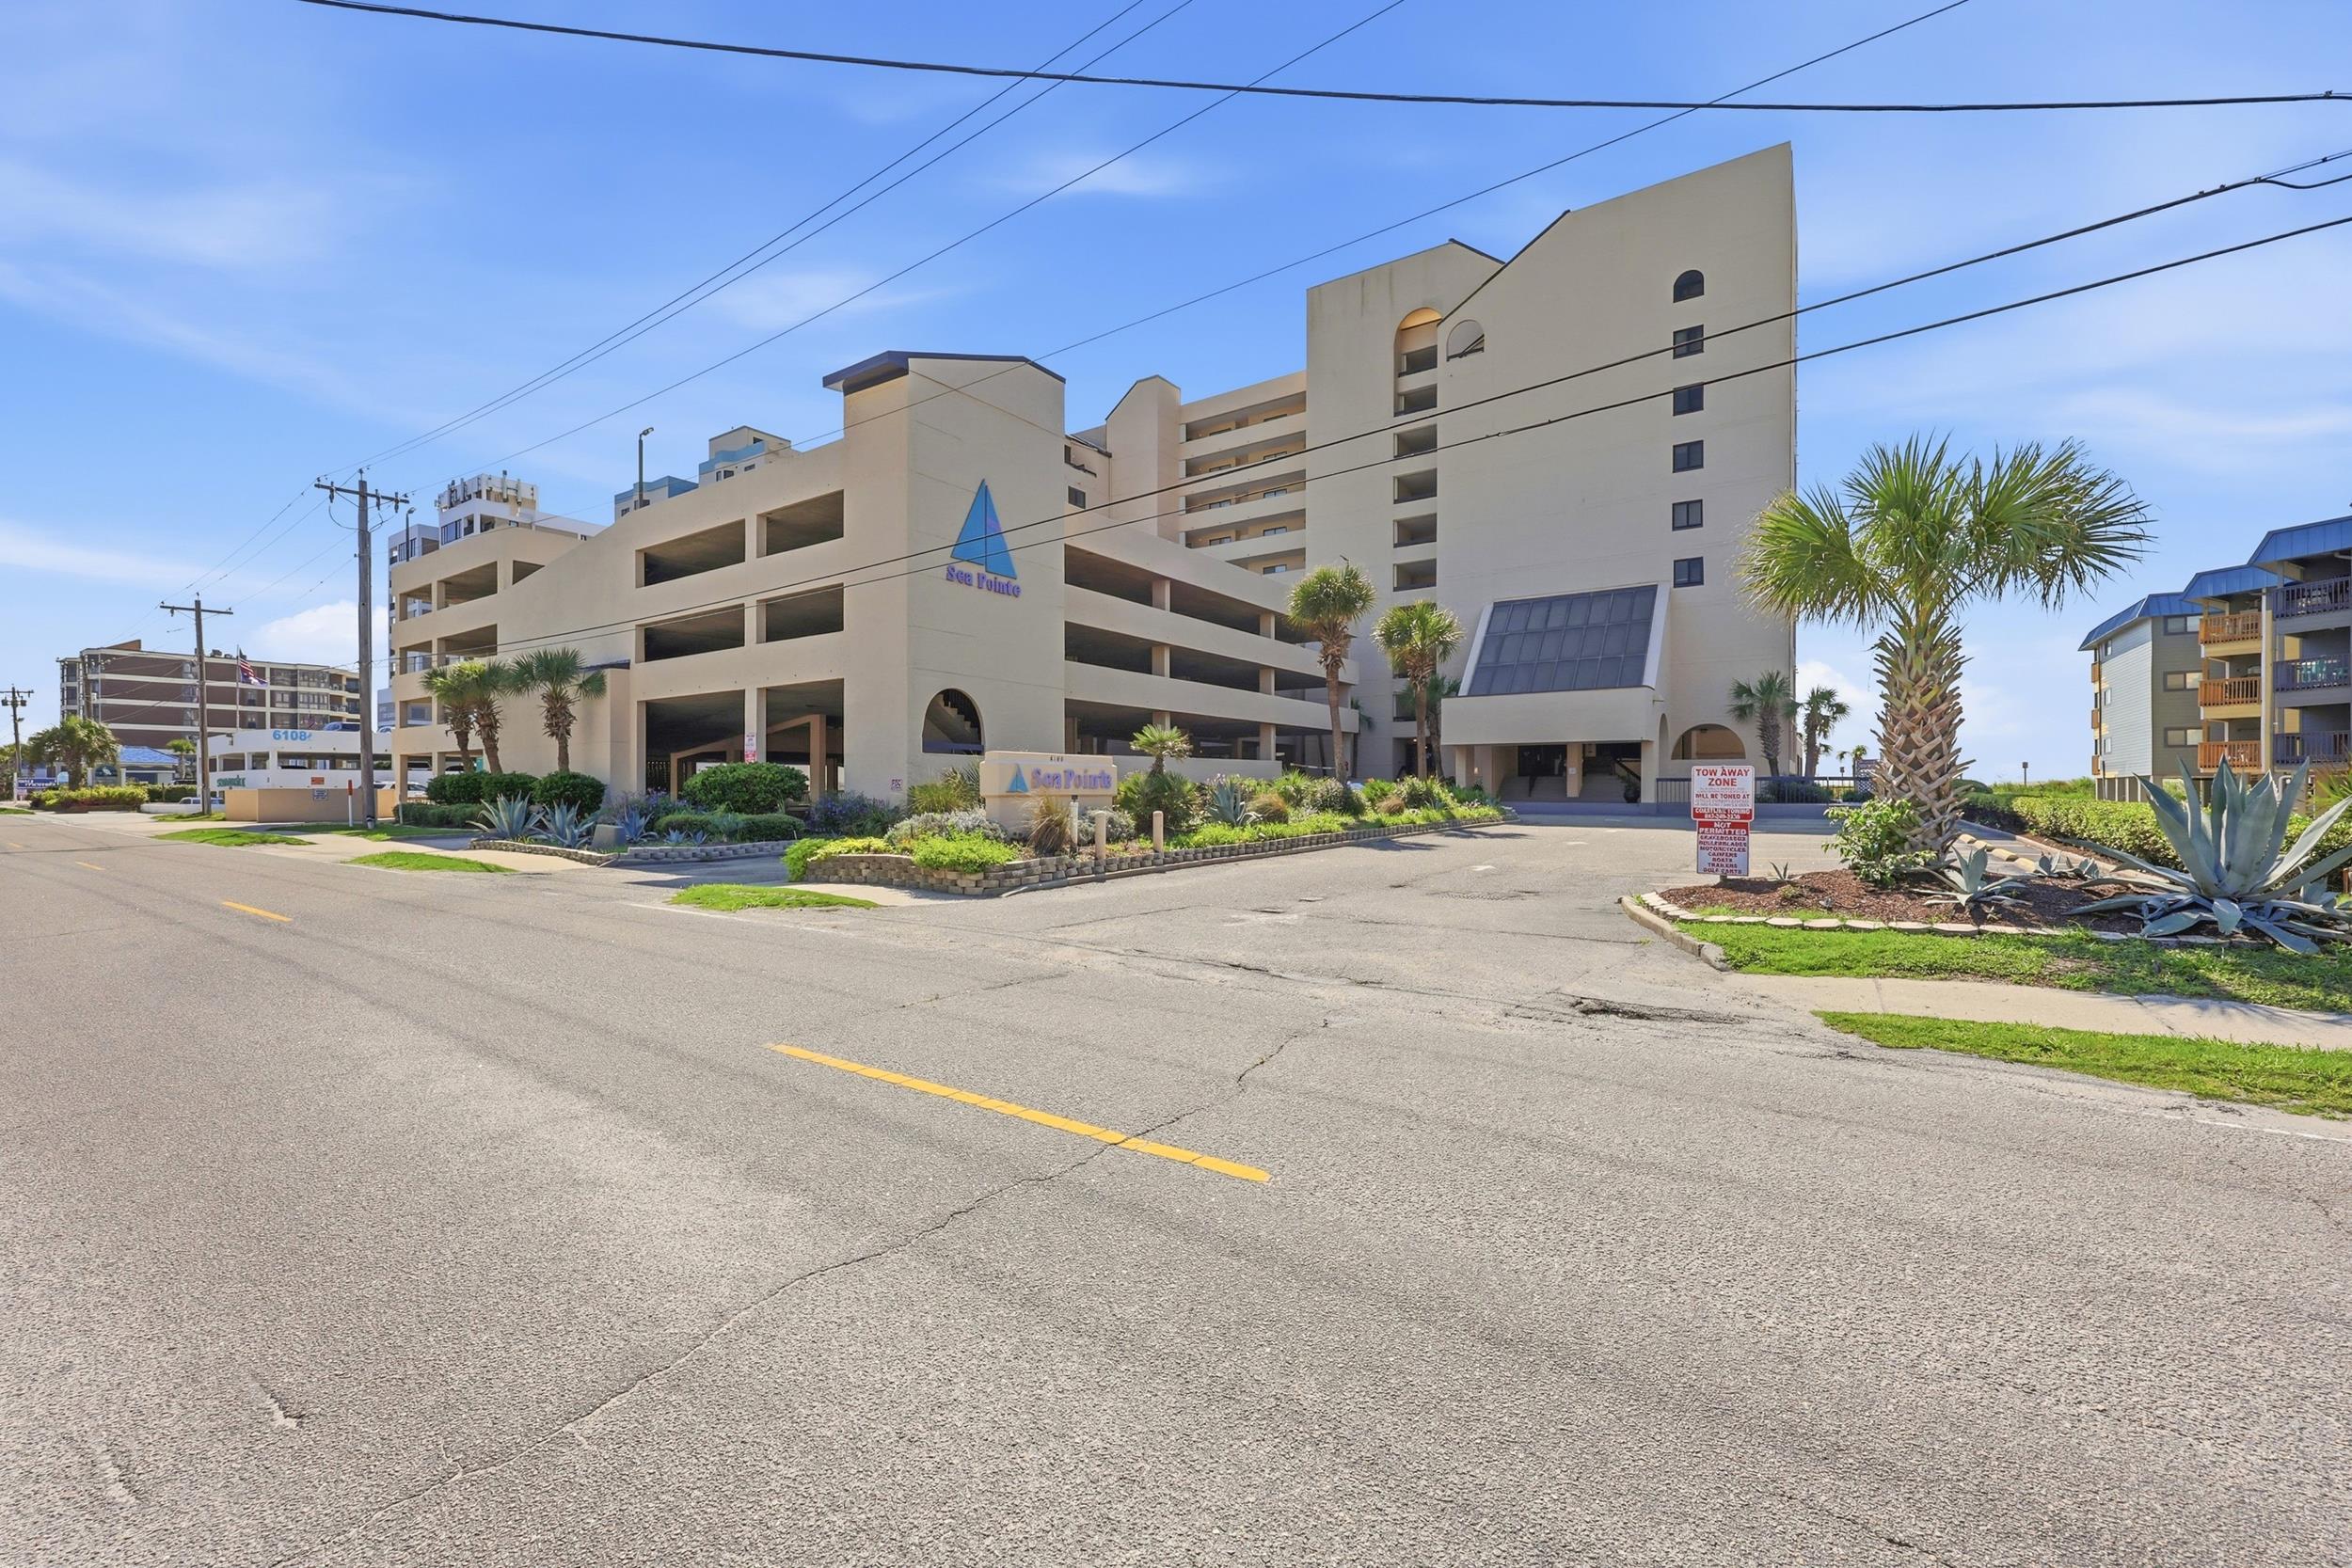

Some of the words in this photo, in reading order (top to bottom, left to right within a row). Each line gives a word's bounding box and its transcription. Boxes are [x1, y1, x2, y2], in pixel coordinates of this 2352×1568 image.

[946, 565, 974, 586] Sea
[977, 572, 1023, 598] Pointe
[273, 730, 307, 741] 6108
[1695, 768, 1717, 777] TOW
[1721, 768, 1750, 777] AWAY
[1030, 768, 1062, 790] Sea
[1063, 768, 1112, 790] Pointe
[1708, 778, 1737, 786] ZONE
